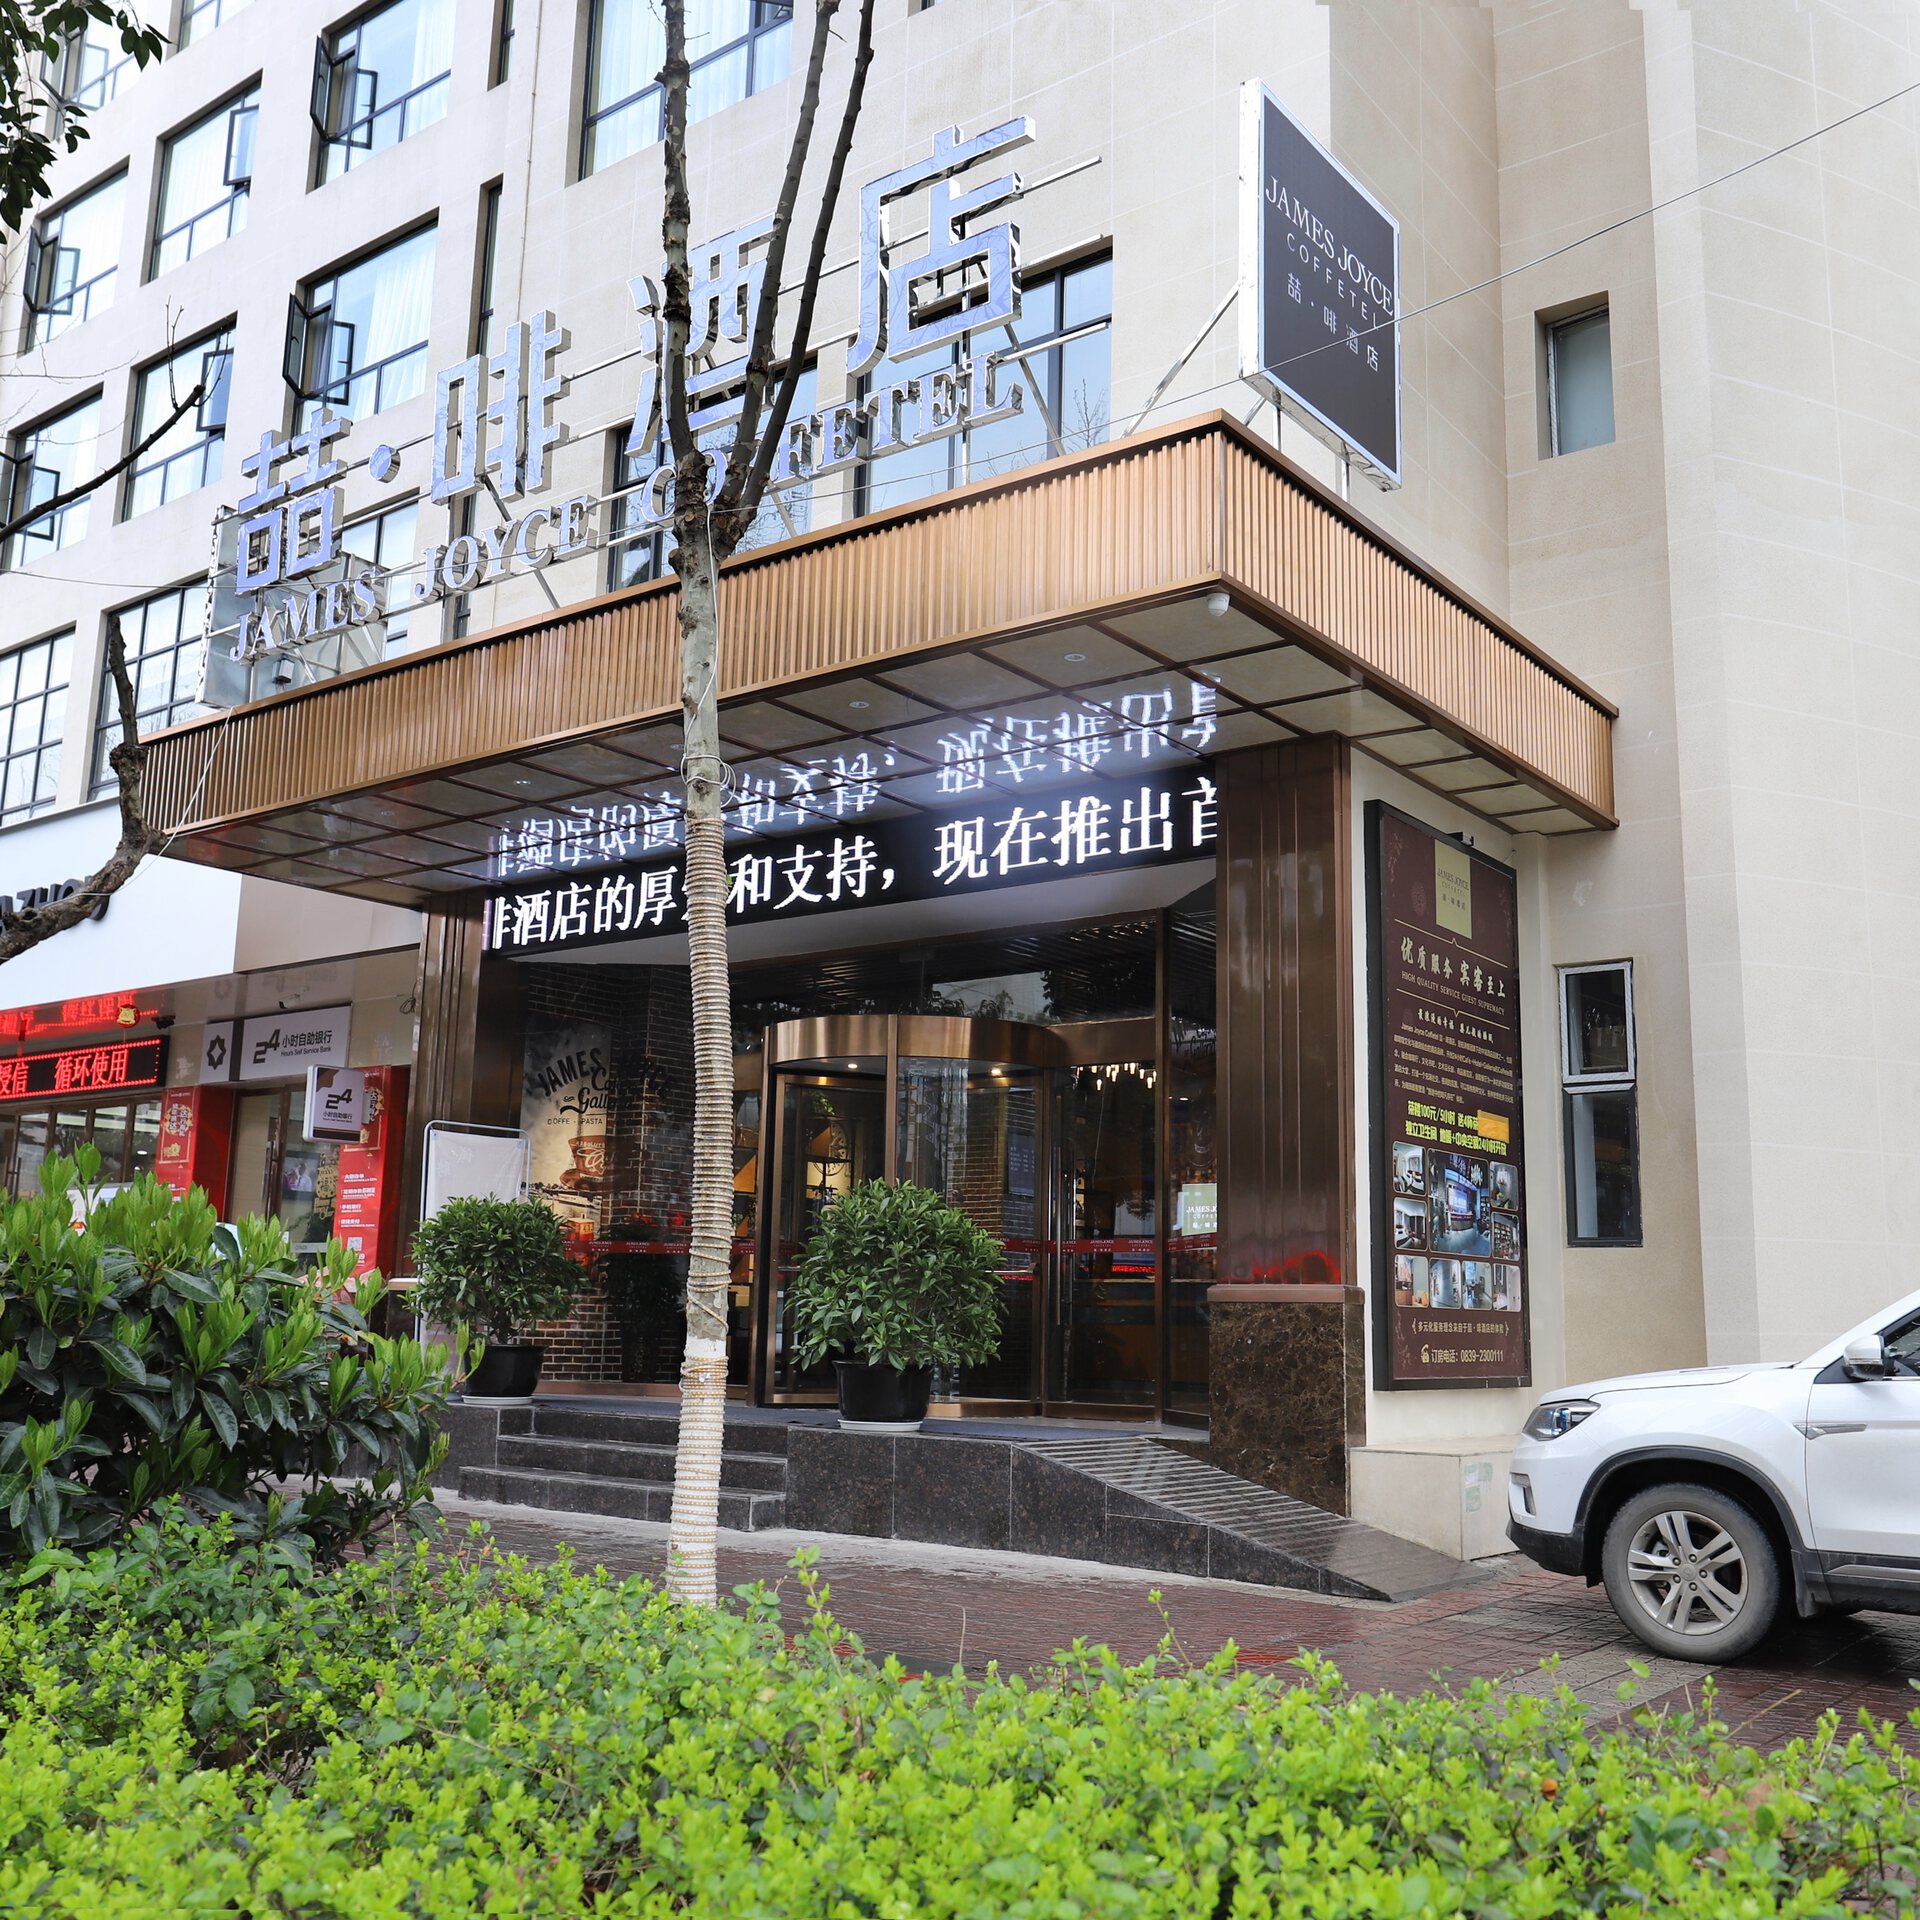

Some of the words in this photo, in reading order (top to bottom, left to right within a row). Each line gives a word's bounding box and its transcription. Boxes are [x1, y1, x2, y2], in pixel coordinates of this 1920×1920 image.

[1265, 175, 1335, 259] JAMES
[1337, 244, 1395, 316] JOYCE
[1286, 232, 1379, 331] COFFETEL
[1287, 272, 1379, 372] 喆·啡酒店
[229, 568, 384, 665] JAMES
[414, 494, 597, 604] JOYCE
[640, 350, 1024, 530] COFETEL
[1401, 936, 1453, 979] 优质服务
[1460, 960, 1506, 998] 宾客至上
[1402, 970, 1416, 982] HIGH
[1416, 976, 1439, 991] QUALITY
[1440, 984, 1461, 1000] SERVICE
[1461, 992, 1477, 1006] GUEST
[1477, 998, 1505, 1016] SUPREMACY
[54, 1048, 129, 1090] 循环使用
[253, 1028, 281, 1064] 24
[282, 1030, 333, 1048] 小时自助银行
[537, 1047, 602, 1097] JAMES
[325, 1088, 353, 1110] 24
[581, 1117, 603, 1125] PASTA
